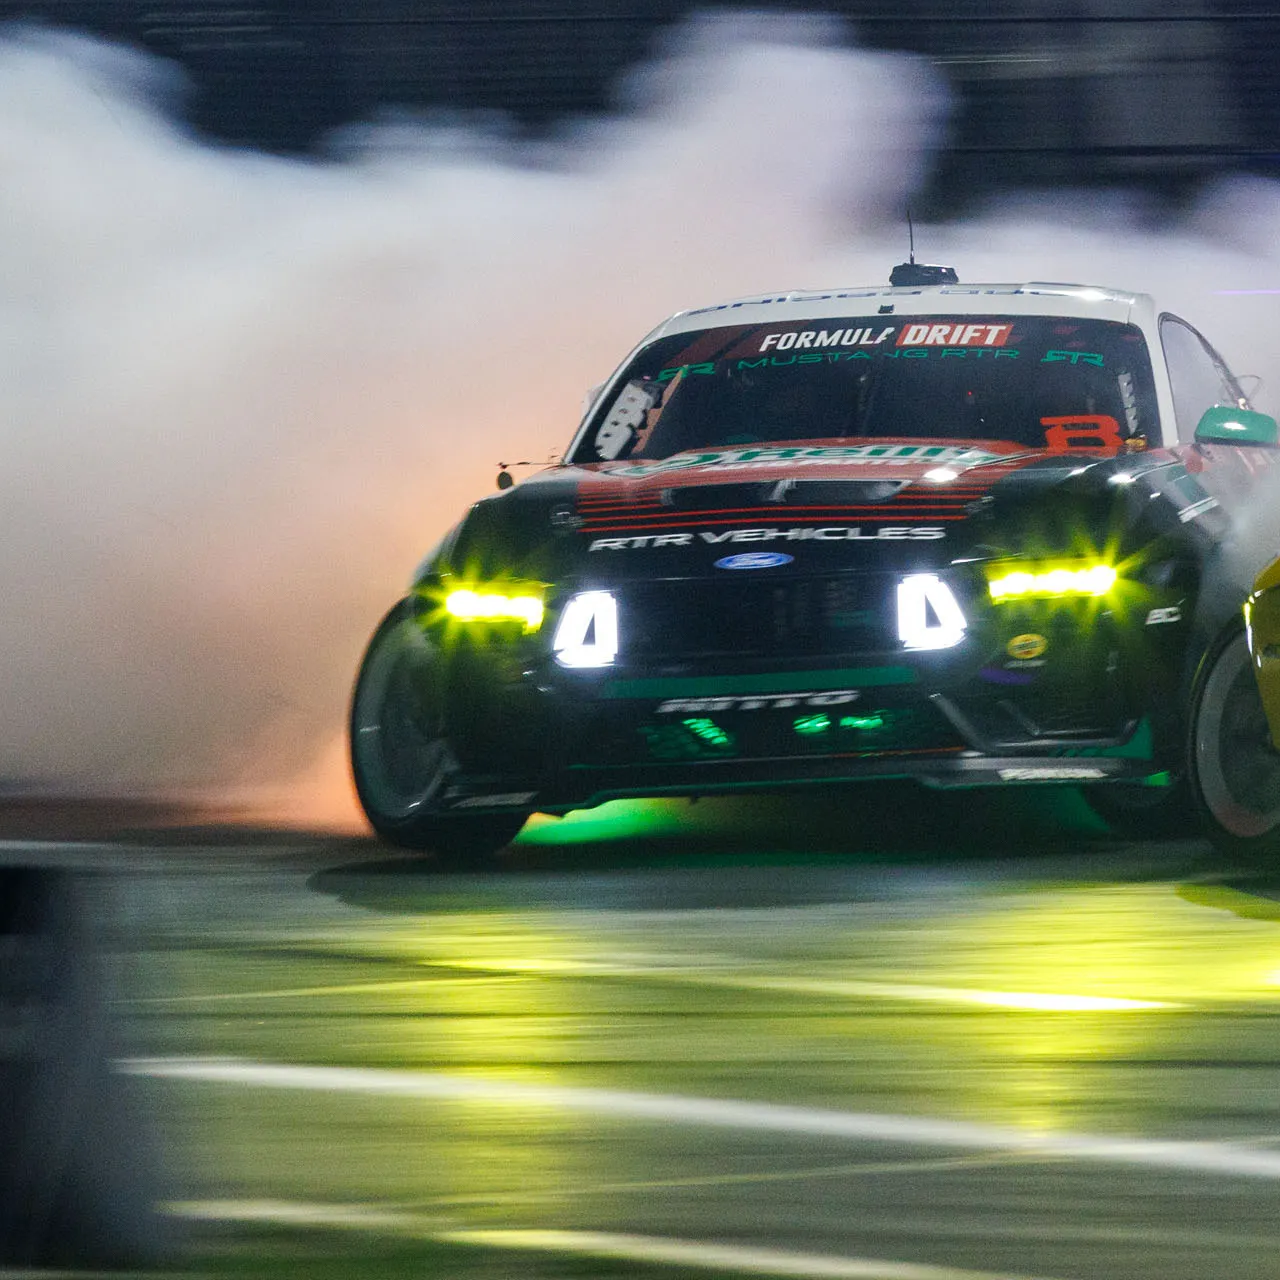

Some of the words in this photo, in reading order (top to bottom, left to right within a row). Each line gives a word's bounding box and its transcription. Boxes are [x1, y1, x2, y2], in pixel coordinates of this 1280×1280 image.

[759, 327, 896, 352] FORMULA
[903, 324, 1007, 346] DRIFT
[941, 348, 1020, 359] RTR
[589, 533, 694, 552] RTR
[701, 526, 946, 544] VEHICLES
